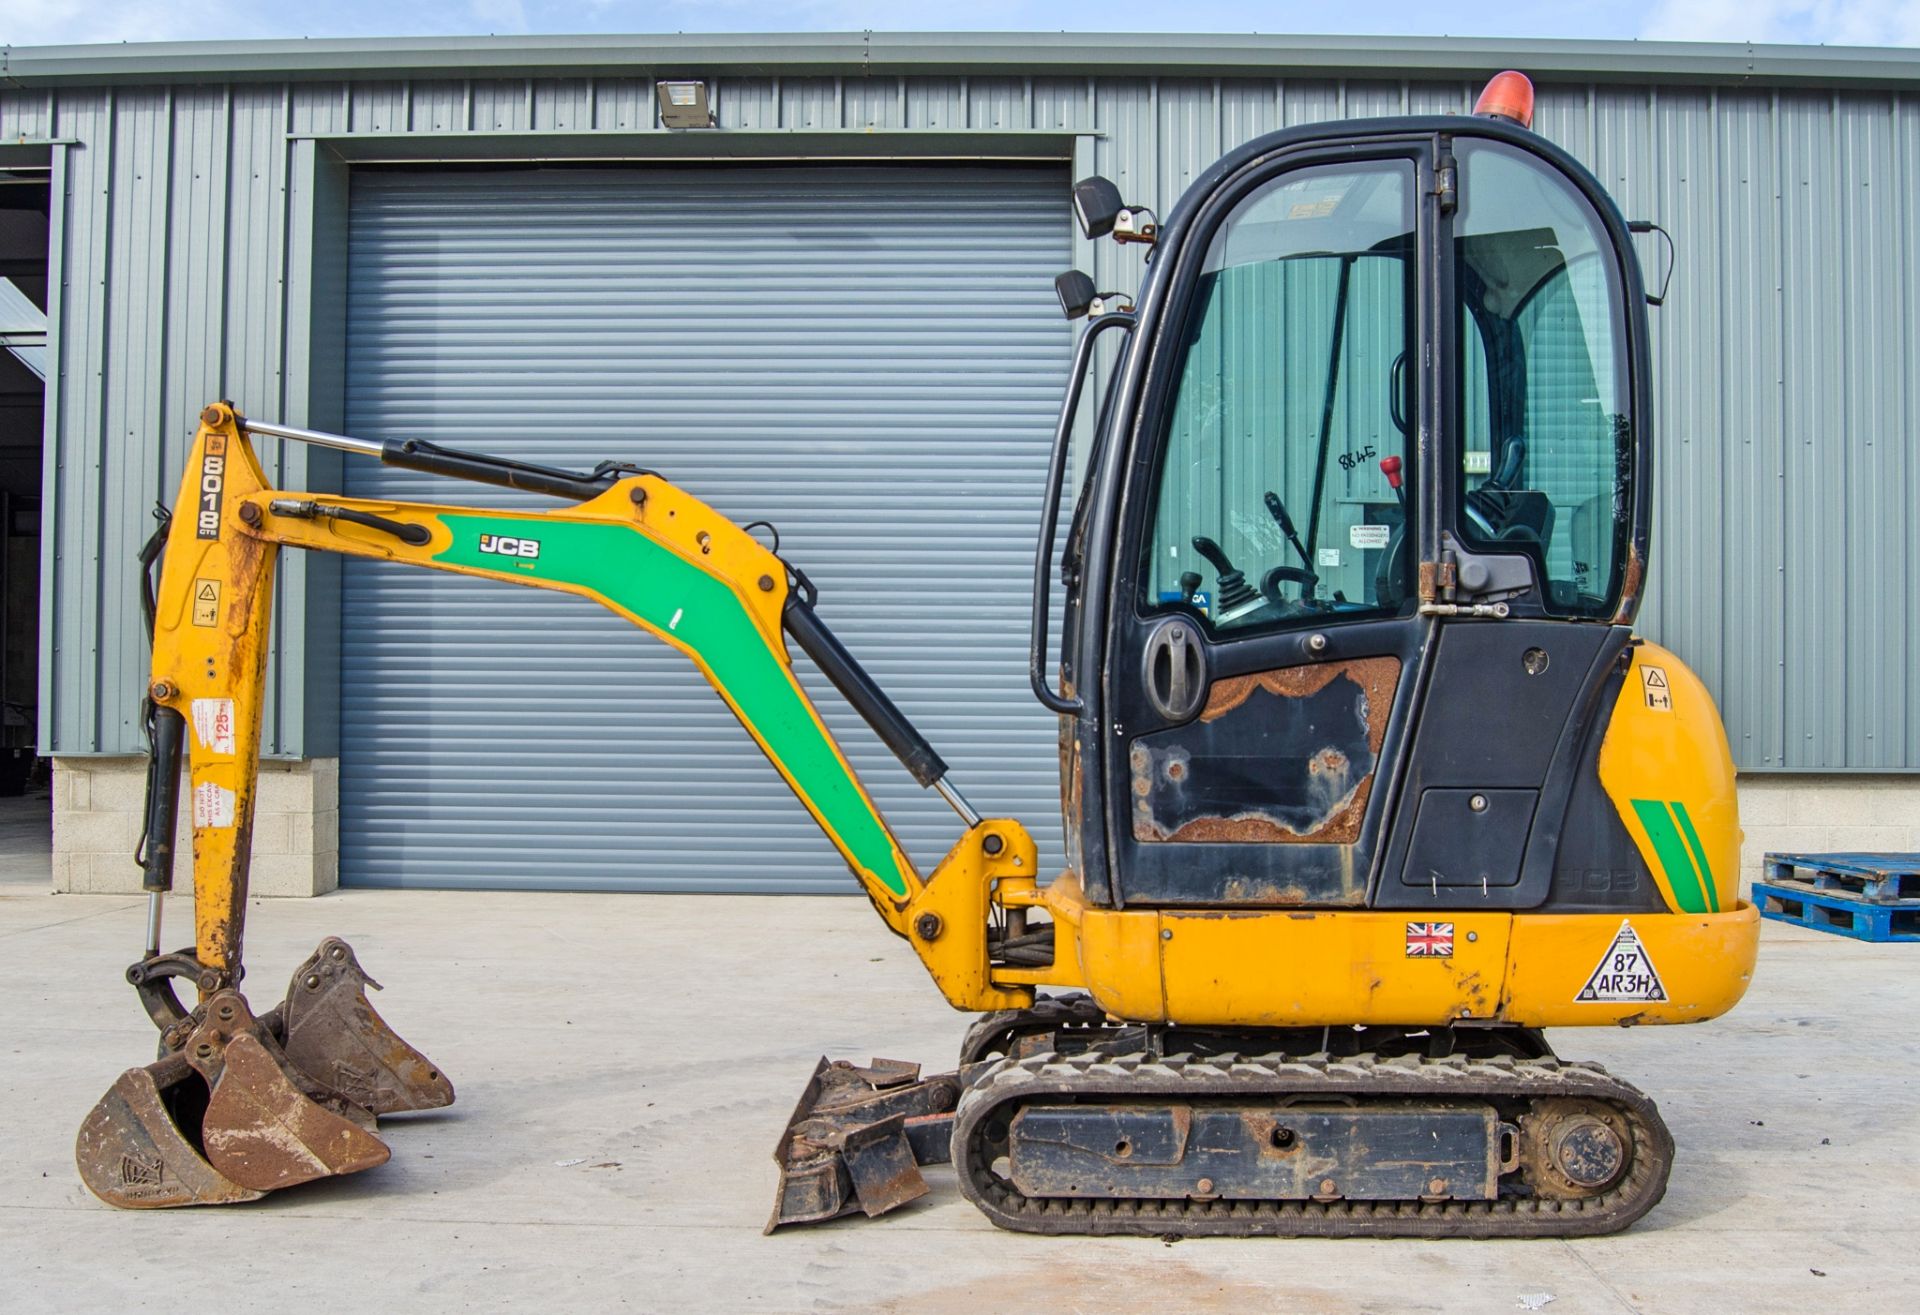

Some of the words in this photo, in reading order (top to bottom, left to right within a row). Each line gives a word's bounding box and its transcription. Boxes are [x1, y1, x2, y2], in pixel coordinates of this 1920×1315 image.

[1338, 445, 1376, 470] 8845
[200, 456, 223, 529] 8018
[480, 535, 539, 558] JCB
[1560, 869, 1638, 892] JCB
[1614, 953, 1637, 972] 87
[1598, 974, 1650, 993] AR3H
